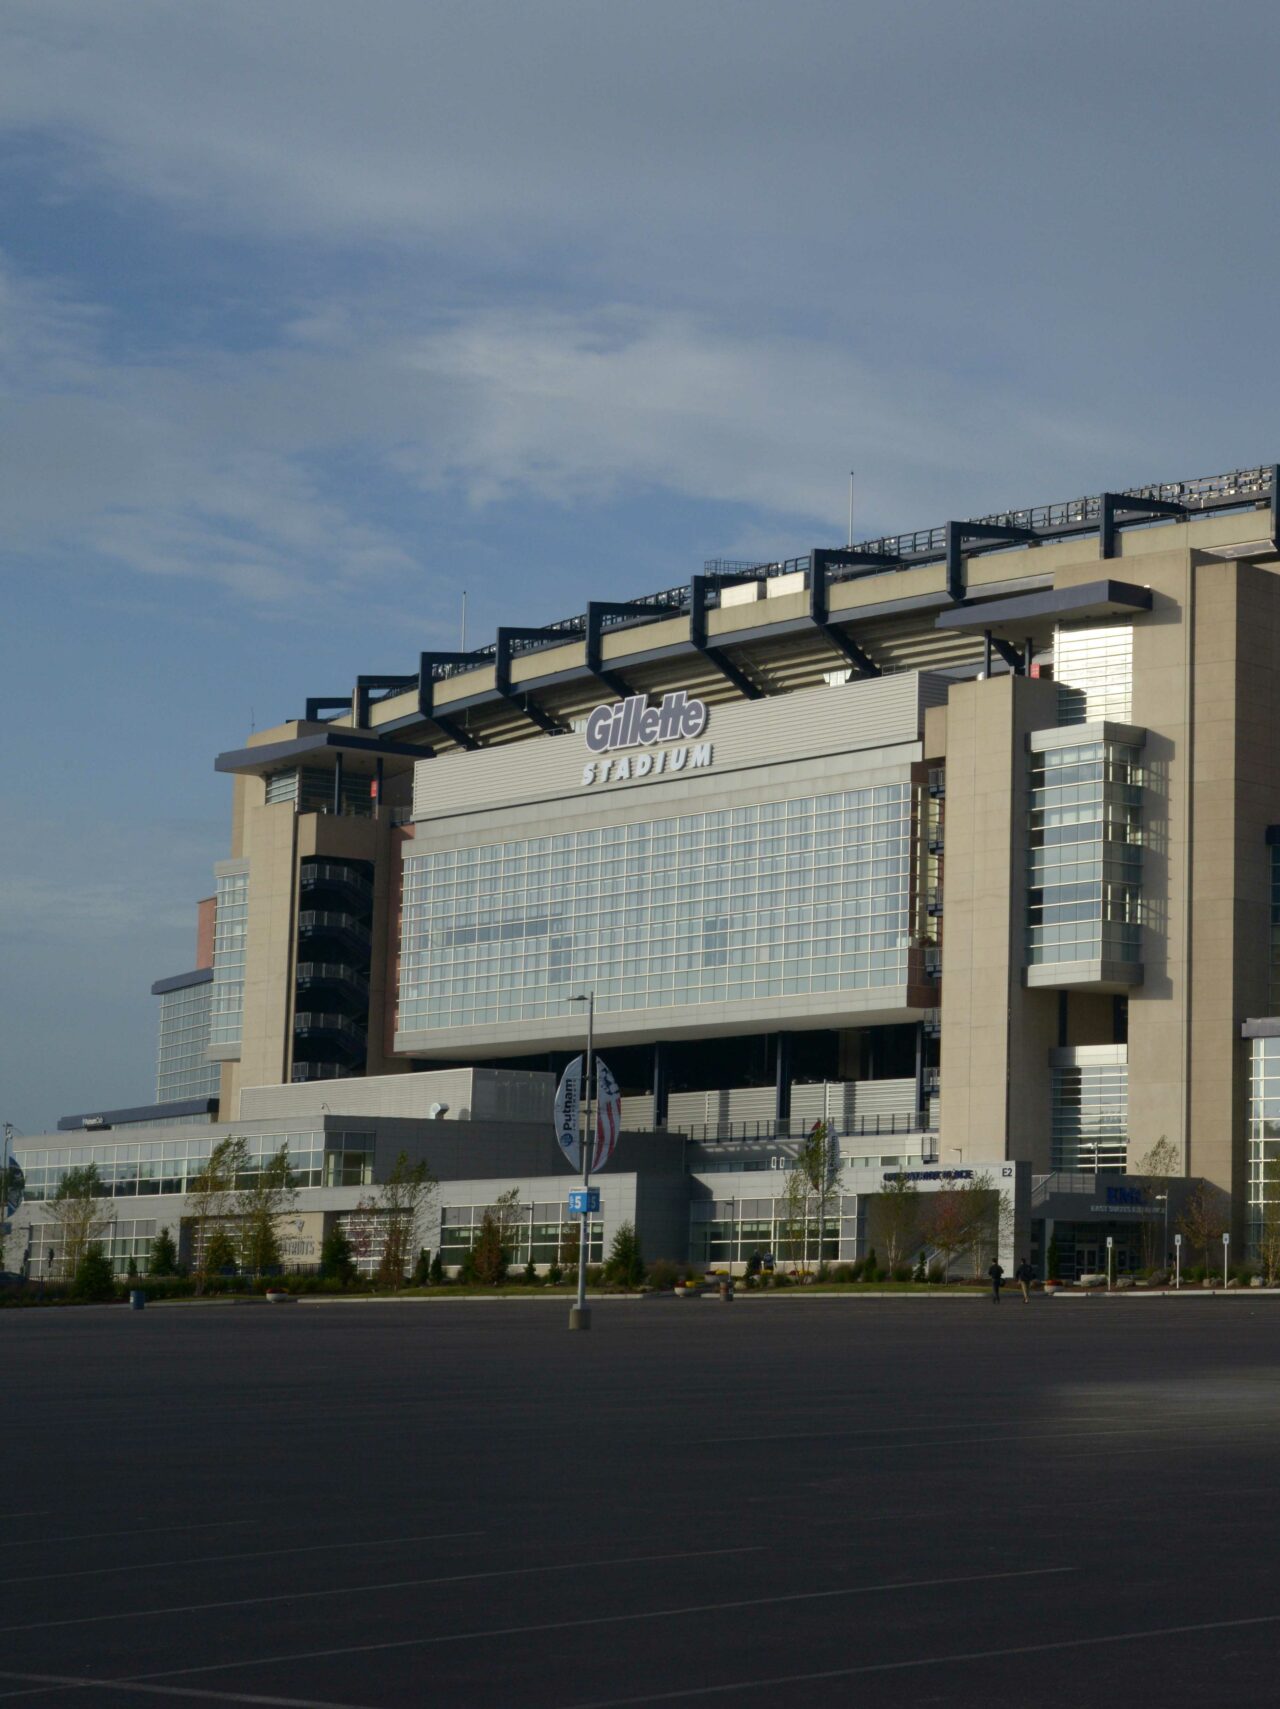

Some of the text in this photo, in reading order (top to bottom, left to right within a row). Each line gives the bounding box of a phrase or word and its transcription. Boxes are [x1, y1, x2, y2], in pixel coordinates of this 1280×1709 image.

[586, 690, 707, 753] Gillette
[583, 743, 712, 785] STADIUM
[563, 1079, 573, 1131] Putnam
[1002, 1167, 1013, 1177] E2
[574, 1195, 582, 1209] 5
